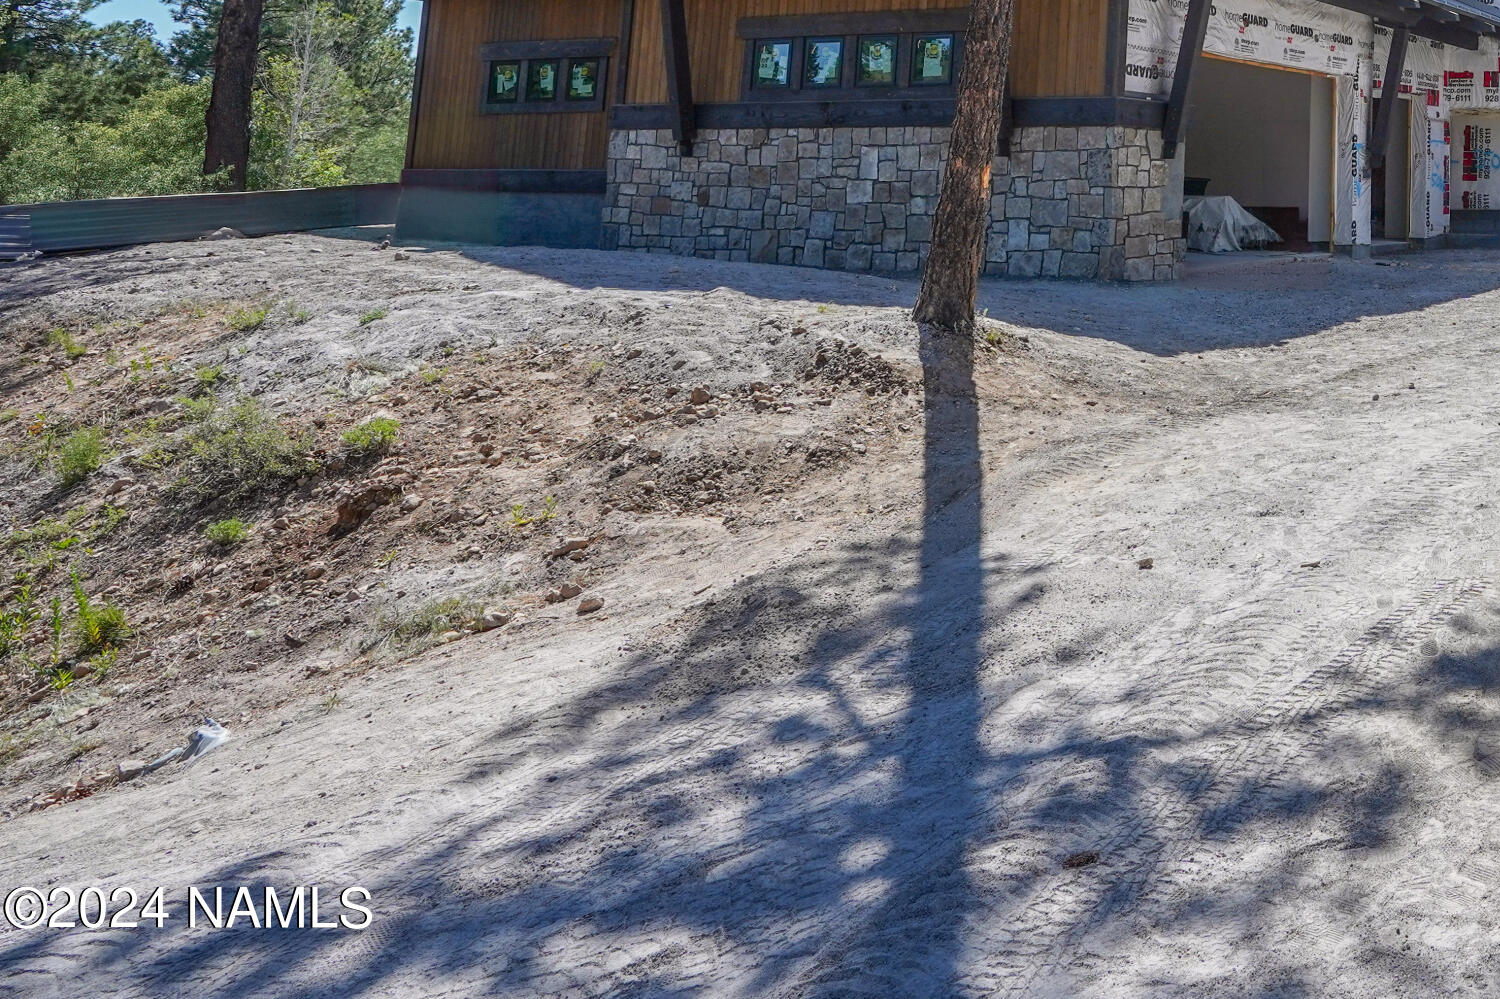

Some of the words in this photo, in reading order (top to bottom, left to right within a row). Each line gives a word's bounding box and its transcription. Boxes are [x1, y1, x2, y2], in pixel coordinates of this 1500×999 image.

[1224, 8, 1269, 28] homeGUARD
[1274, 21, 1314, 38] homeGUARD
[1318, 31, 1353, 46] homeGUARD
[1126, 63, 1175, 80] omeGUARD
